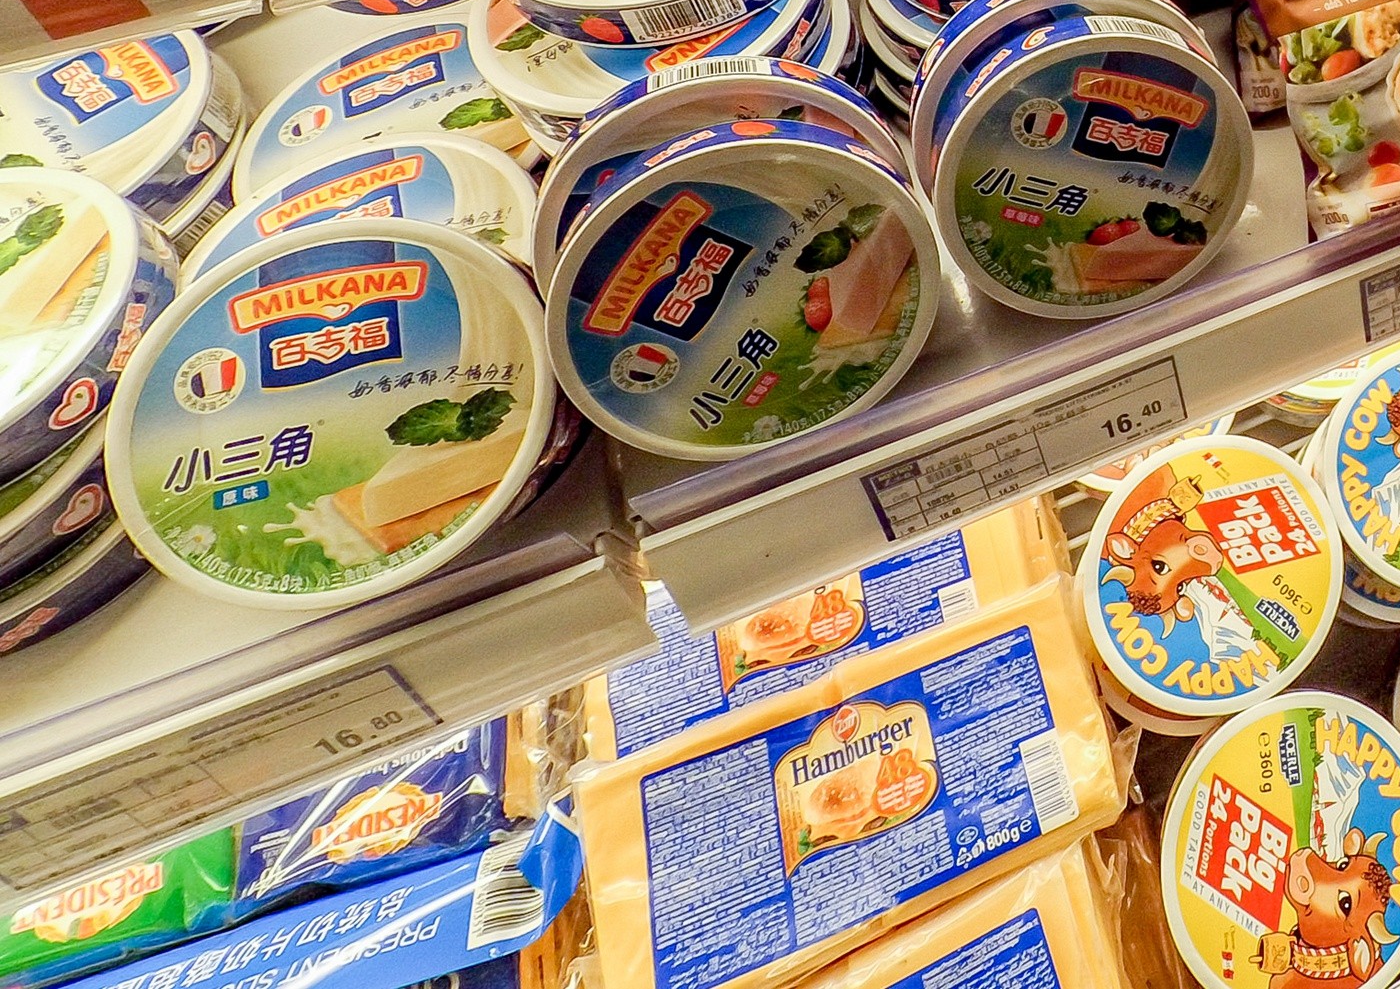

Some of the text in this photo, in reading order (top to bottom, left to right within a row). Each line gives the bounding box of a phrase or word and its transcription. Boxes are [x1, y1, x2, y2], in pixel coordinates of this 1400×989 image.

[651, 25, 695, 41] 922477
[335, 35, 448, 86] MILKANA
[348, 61, 437, 108] 百吉福
[52, 59, 119, 114] 百吉福
[1089, 78, 1197, 120] MILKANA
[1251, 85, 1271, 99] 200
[1087, 116, 1172, 158] 百吉福
[276, 162, 408, 225] MILKANA
[972, 166, 1091, 217] 小三角
[1321, 211, 1342, 225] 200
[599, 202, 692, 320] MILKANA
[654, 237, 736, 328] 百吉福
[251, 270, 410, 321] MILKANA
[269, 318, 390, 371] 百吉福
[690, 327, 780, 432] 小三角
[1100, 399, 1163, 439] 16.40
[1345, 378, 1394, 451] COW
[164, 425, 316, 493] 小三角
[221, 484, 260, 508] 原味
[1221, 518, 1263, 568] Big
[1235, 494, 1295, 564] Pack
[1271, 489, 1318, 556] 24 Portions
[1257, 598, 1300, 641] WOERLE
[1104, 600, 1281, 697] HAPPY COW
[312, 708, 406, 759] 16.80
[790, 715, 914, 787] Hamburger
[1284, 724, 1301, 786] WOERLE
[876, 747, 916, 784] 48
[1190, 789, 1206, 831] GOOD
[1198, 778, 1232, 877] 24 Portions
[984, 824, 1021, 851] 800g
[1182, 837, 1199, 879] TASTE
[1220, 792, 1256, 902] Pack
[1247, 818, 1289, 893] Big
[1208, 894, 1231, 916] ANY
[1235, 910, 1261, 936] TIME
